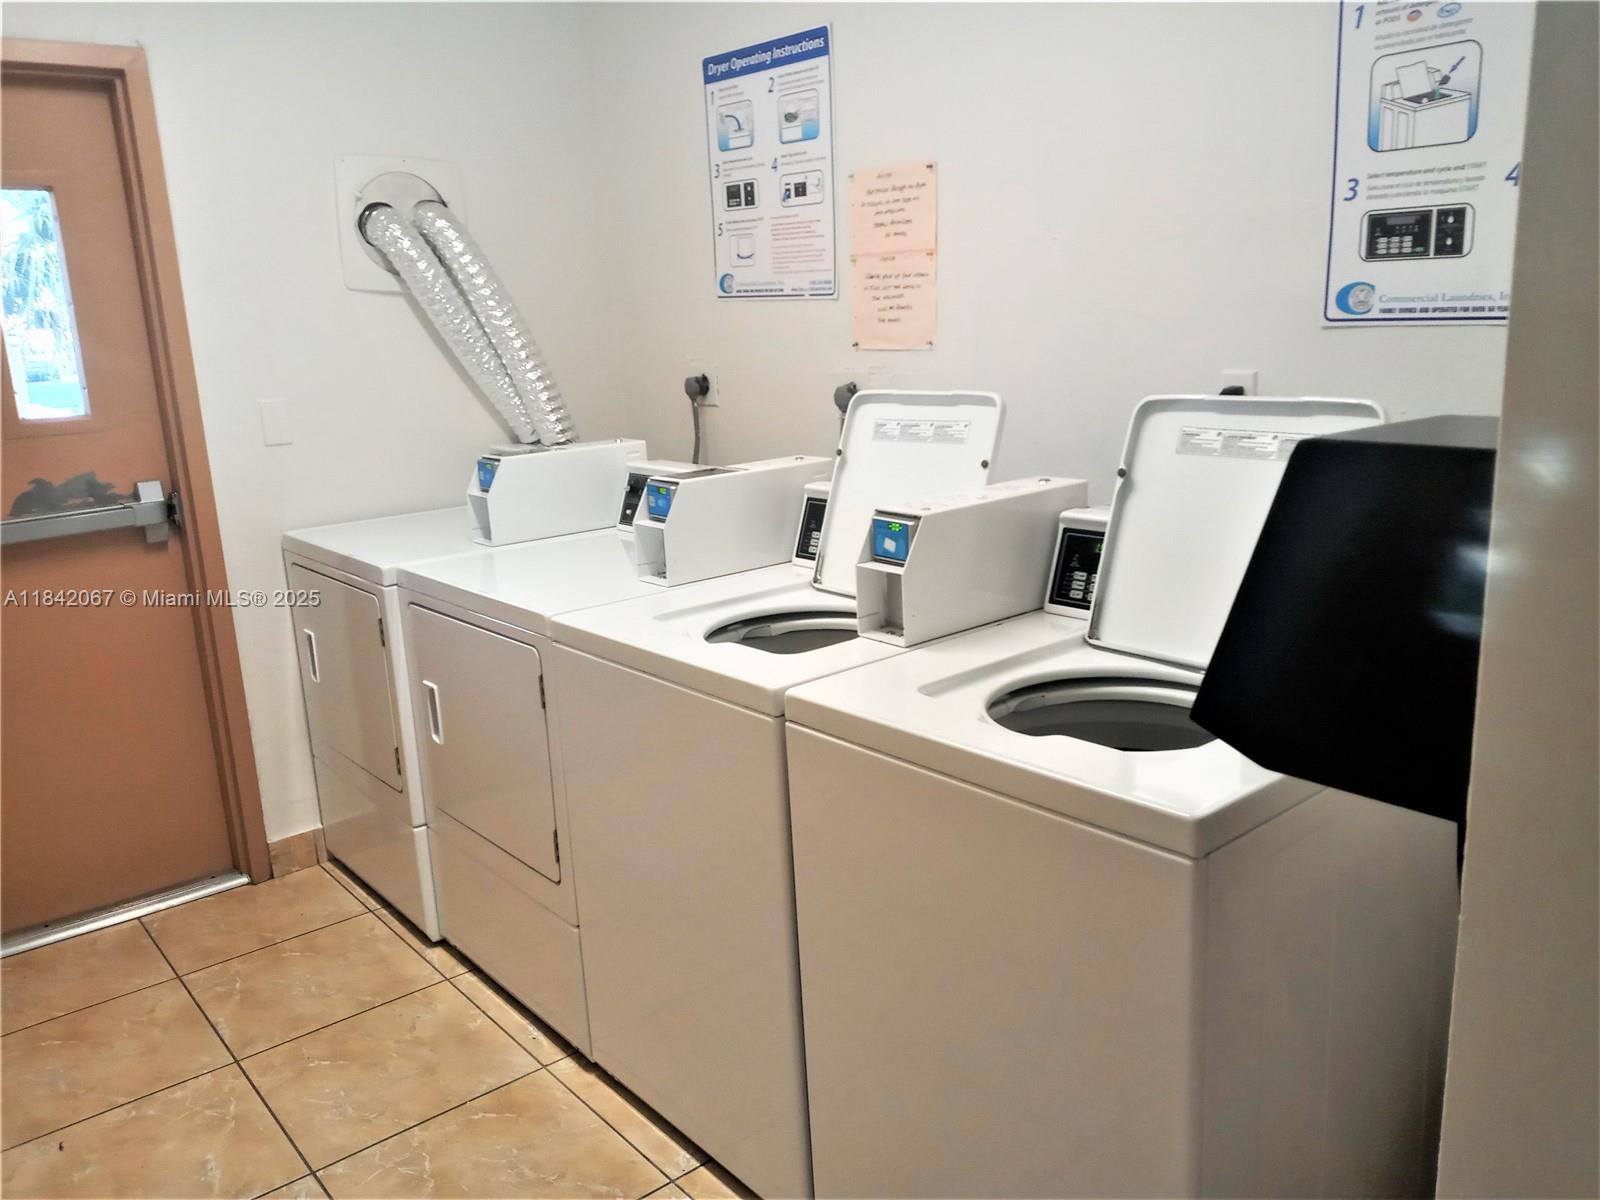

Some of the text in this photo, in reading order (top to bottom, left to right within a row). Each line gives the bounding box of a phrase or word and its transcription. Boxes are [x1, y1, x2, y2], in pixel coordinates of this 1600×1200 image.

[1355, 5, 1364, 29] 1
[708, 37, 825, 76] Dryer Operating Instructions
[768, 77, 775, 93] 2
[714, 163, 720, 179] 3
[771, 158, 778, 172] 4
[1505, 161, 1520, 187] 4
[1343, 178, 1359, 202] 3
[717, 223, 724, 237] 5
[1378, 292, 1439, 303] Commercial
